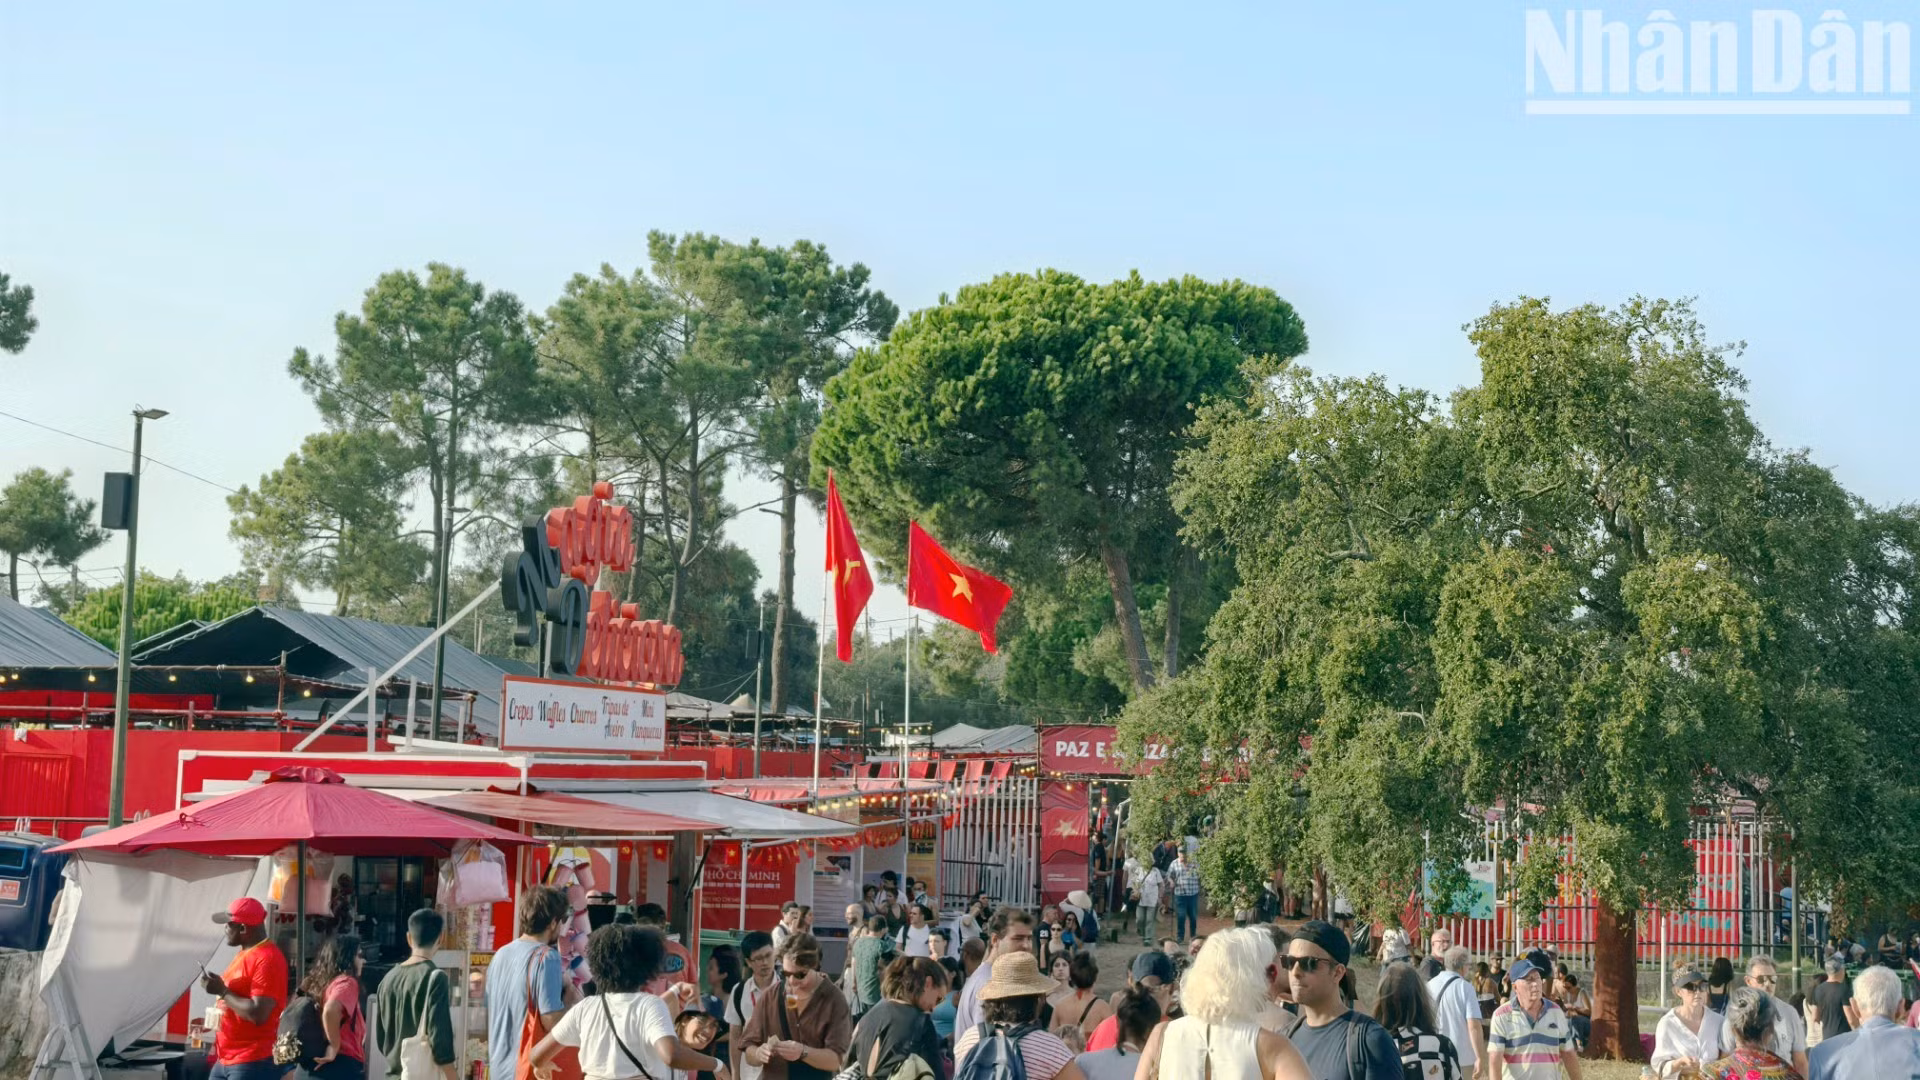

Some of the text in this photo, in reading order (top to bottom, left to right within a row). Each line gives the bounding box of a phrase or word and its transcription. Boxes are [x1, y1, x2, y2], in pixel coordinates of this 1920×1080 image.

[538, 699, 566, 728] Waffles
[570, 702, 598, 725] Churros
[621, 700, 630, 717] de
[604, 718, 625, 739] Aveiro
[630, 719, 663, 744] Panquecas
[1055, 740, 1090, 758] PAZ
[1096, 741, 1106, 758] E
